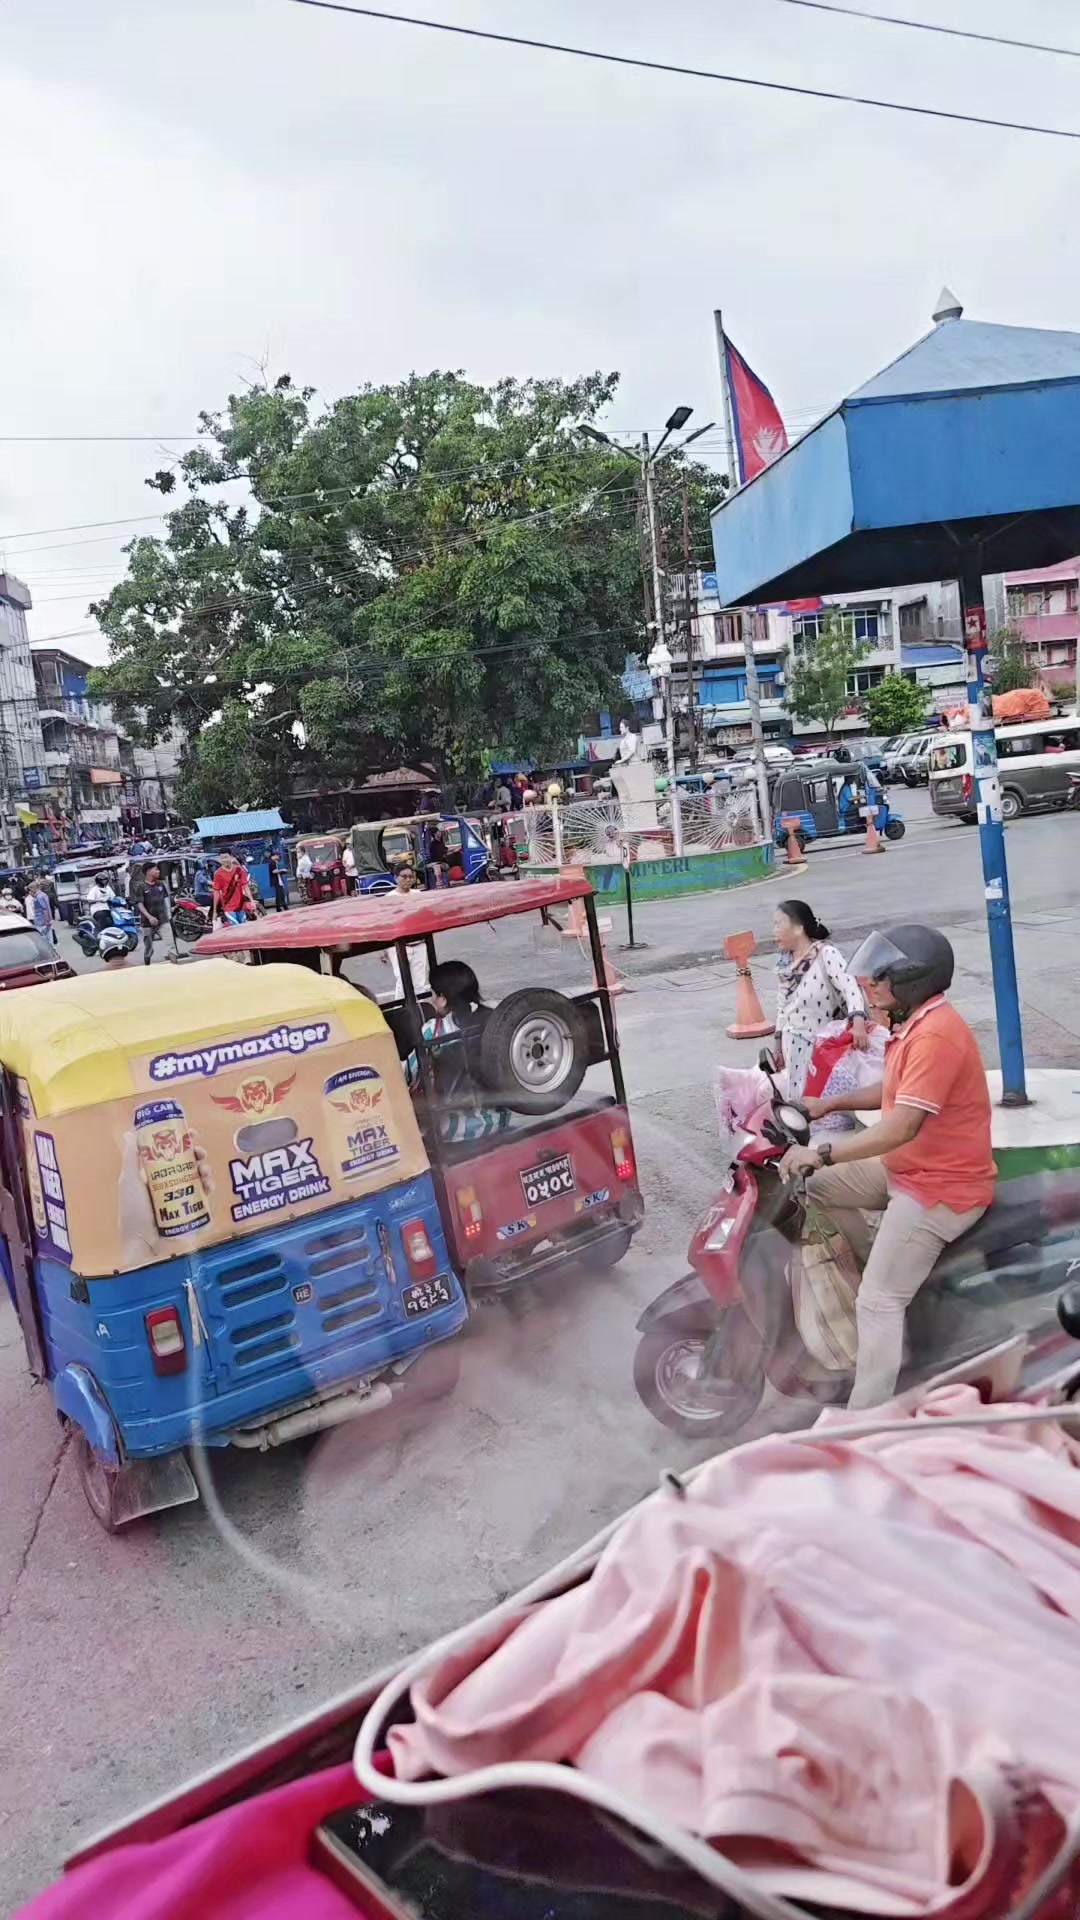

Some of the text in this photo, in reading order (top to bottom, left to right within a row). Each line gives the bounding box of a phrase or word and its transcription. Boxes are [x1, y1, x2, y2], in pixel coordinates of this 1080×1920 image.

[153, 1025, 327, 1077] #mymaxtiger
[347, 1125, 388, 1148] MAX
[349, 1138, 391, 1157] TIGER
[231, 1140, 317, 1185] MAX
[233, 1178, 329, 1219] ENERGY DRINK
[236, 1163, 320, 1199] TIGER
[295, 1289, 310, 1301] RE
